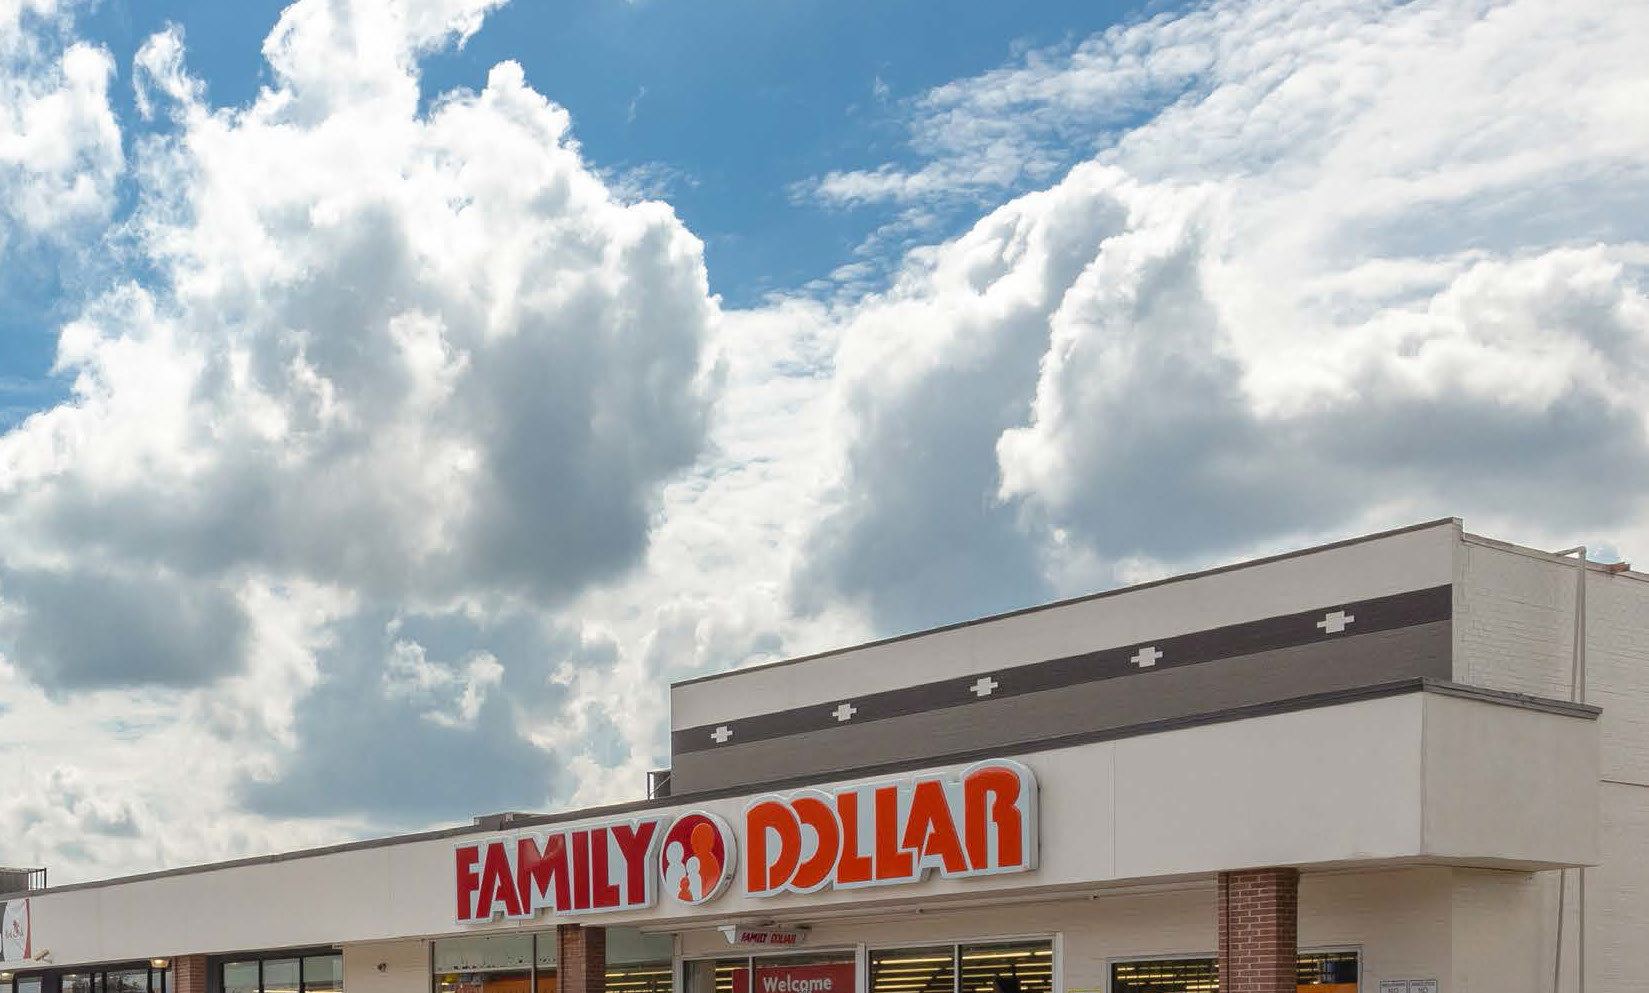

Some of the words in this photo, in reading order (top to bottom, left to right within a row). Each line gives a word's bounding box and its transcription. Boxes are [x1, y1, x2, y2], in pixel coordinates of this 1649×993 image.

[454, 819, 660, 921] FAMILY
[746, 765, 1023, 892] DOLLAR
[741, 932, 768, 943] FAMILY
[763, 974, 832, 993] Welcome
